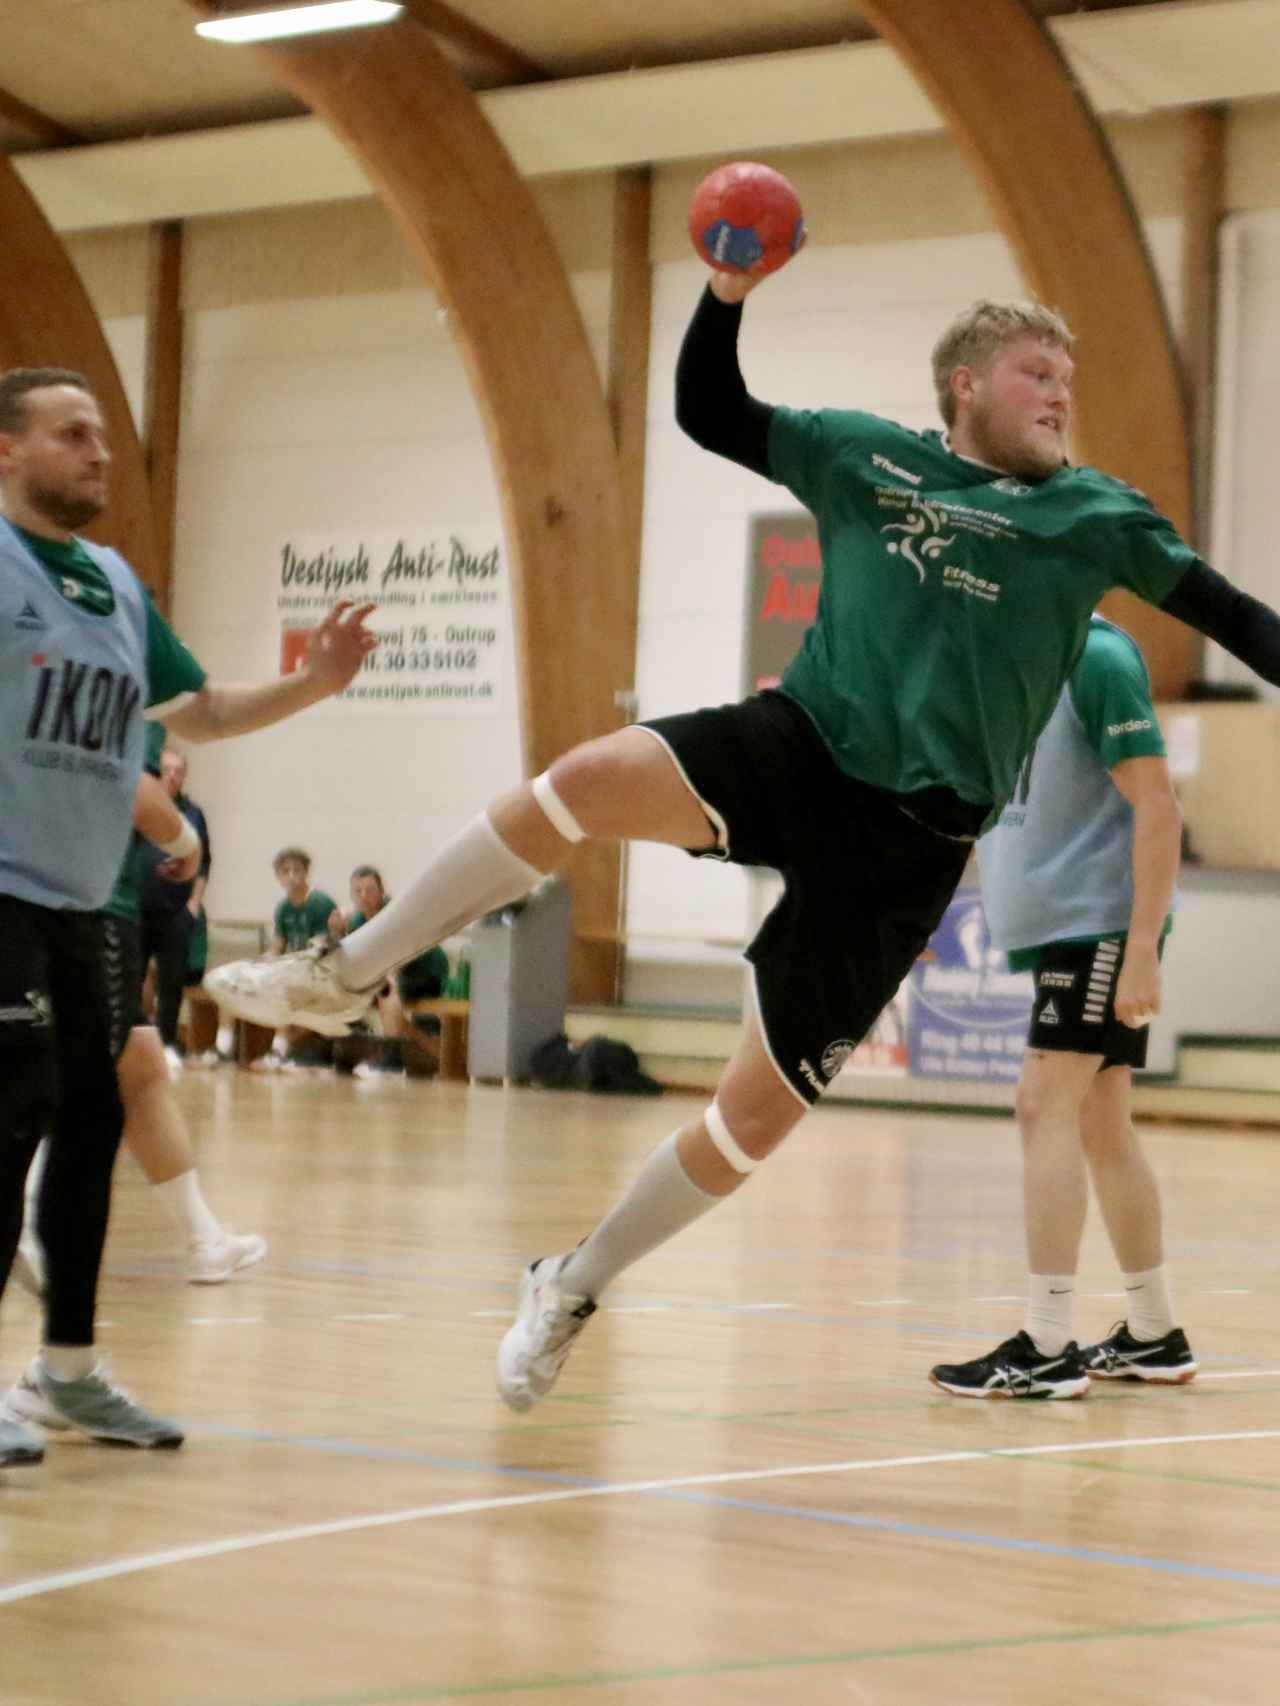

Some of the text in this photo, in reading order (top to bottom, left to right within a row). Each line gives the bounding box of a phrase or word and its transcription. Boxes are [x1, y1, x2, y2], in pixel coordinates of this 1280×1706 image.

[281, 535, 500, 592] Vestjysk Anti-Rust
[445, 623, 497, 648] Outrup
